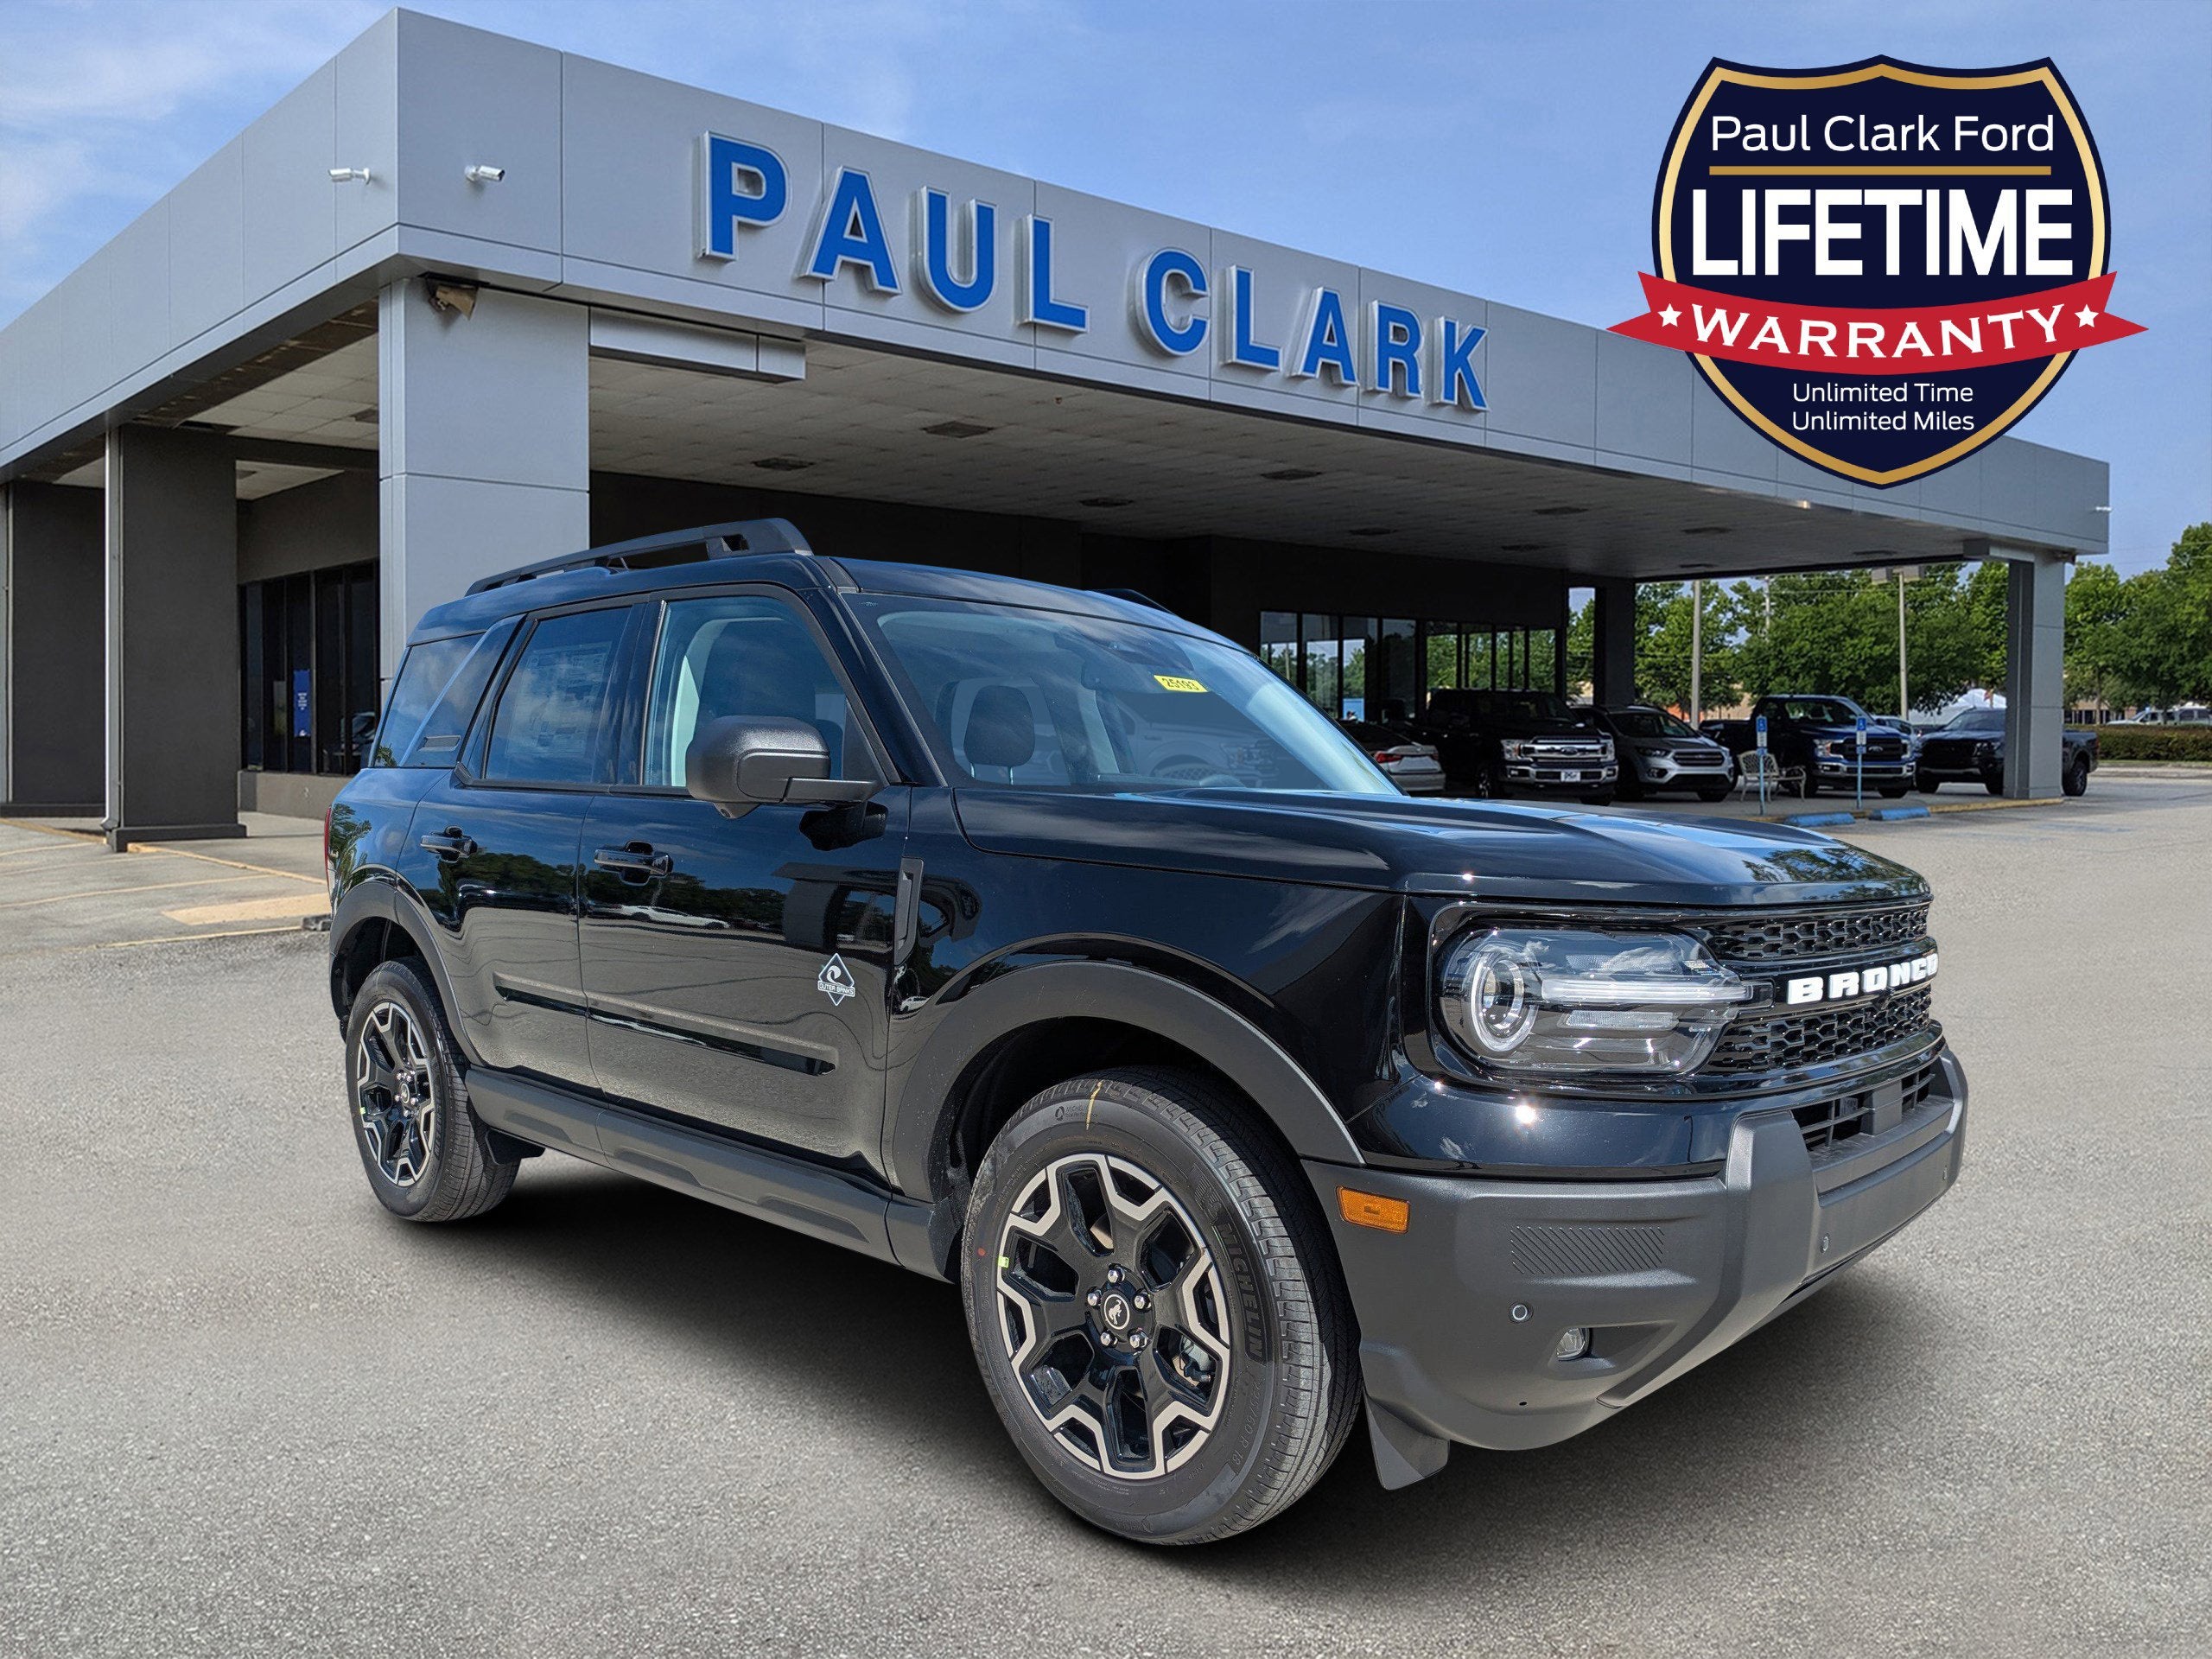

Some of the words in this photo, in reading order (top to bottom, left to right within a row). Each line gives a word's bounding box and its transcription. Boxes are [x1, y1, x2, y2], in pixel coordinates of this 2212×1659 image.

[701, 130, 1089, 333] PAUL
[1135, 247, 1491, 411] CLARK
[1787, 953, 1939, 1005] BRONCO
[1217, 1223, 1263, 1357] MICHELIN
